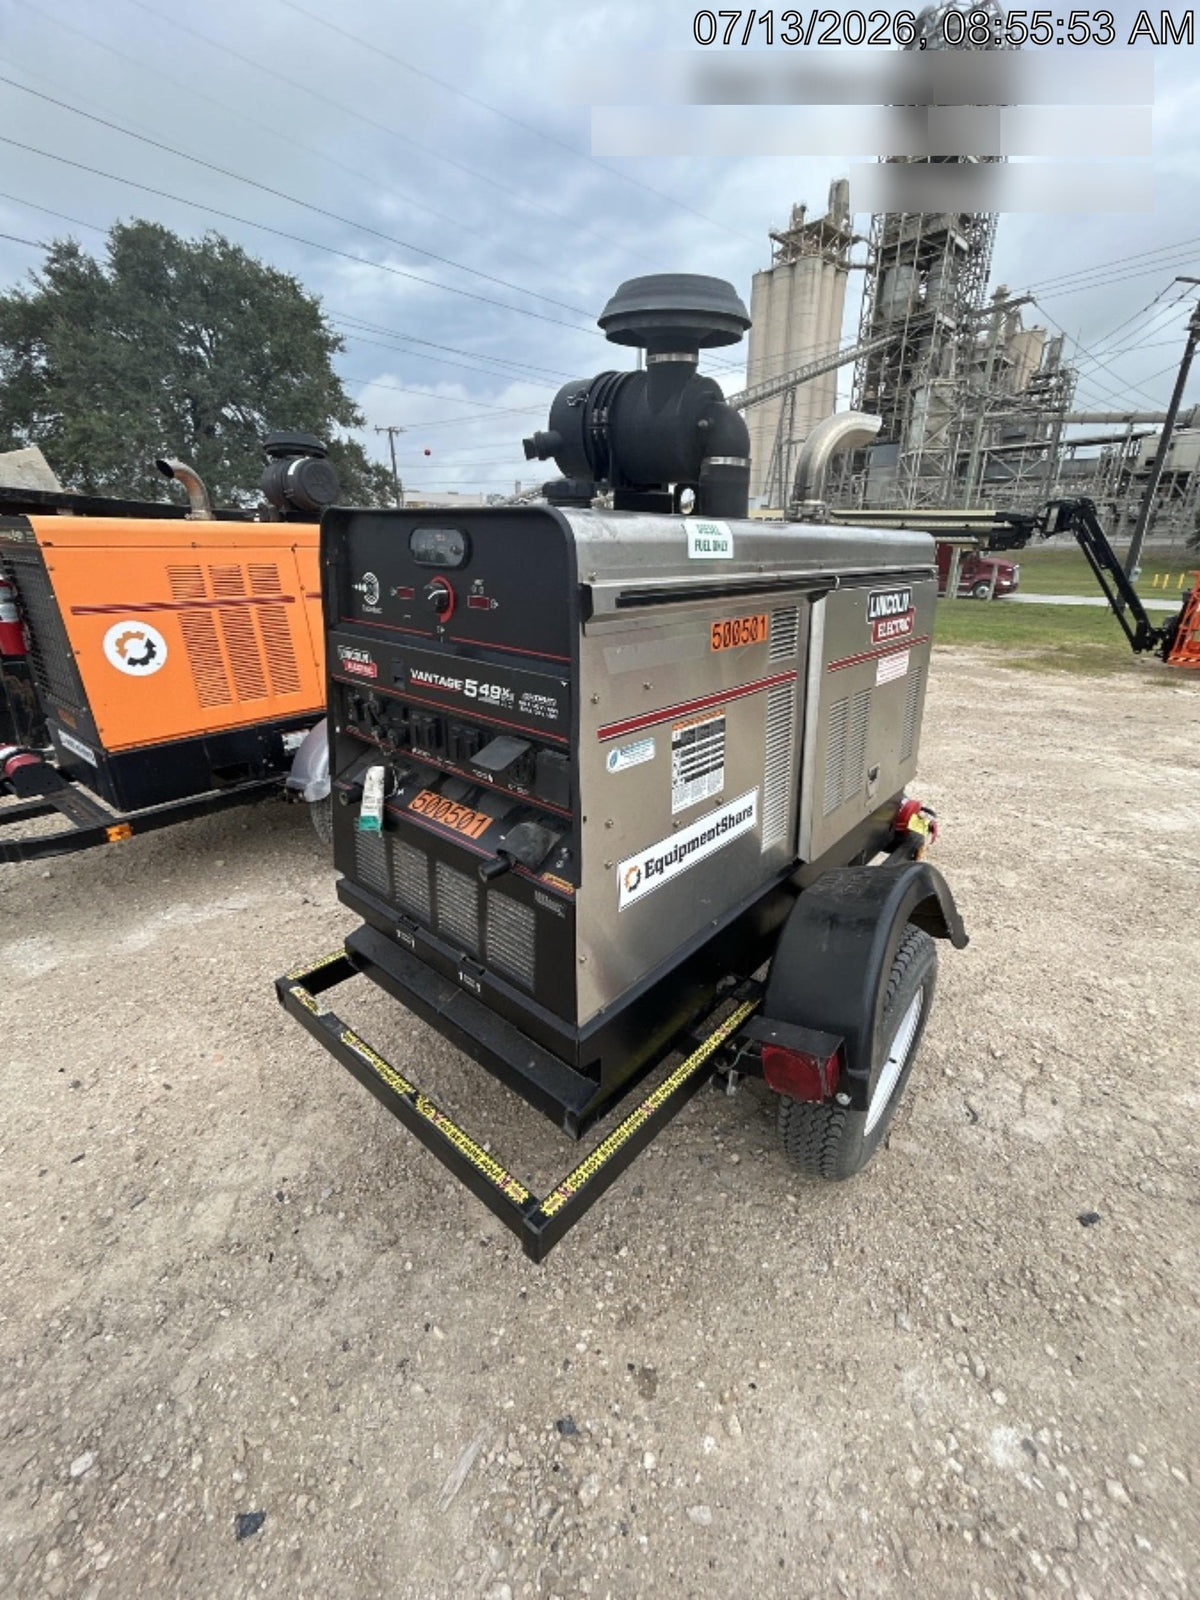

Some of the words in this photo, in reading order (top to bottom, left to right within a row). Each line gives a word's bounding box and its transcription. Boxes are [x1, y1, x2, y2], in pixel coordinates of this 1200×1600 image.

[694, 539, 711, 552] FUEL
[712, 540, 728, 552] ONLY
[869, 593, 910, 618] LINCOLN
[712, 615, 766, 650] 500501
[877, 617, 911, 638] ELECTRIC
[410, 667, 464, 690] VANTAGE
[412, 792, 488, 836] 500501
[644, 805, 753, 879] EquipmentShare
